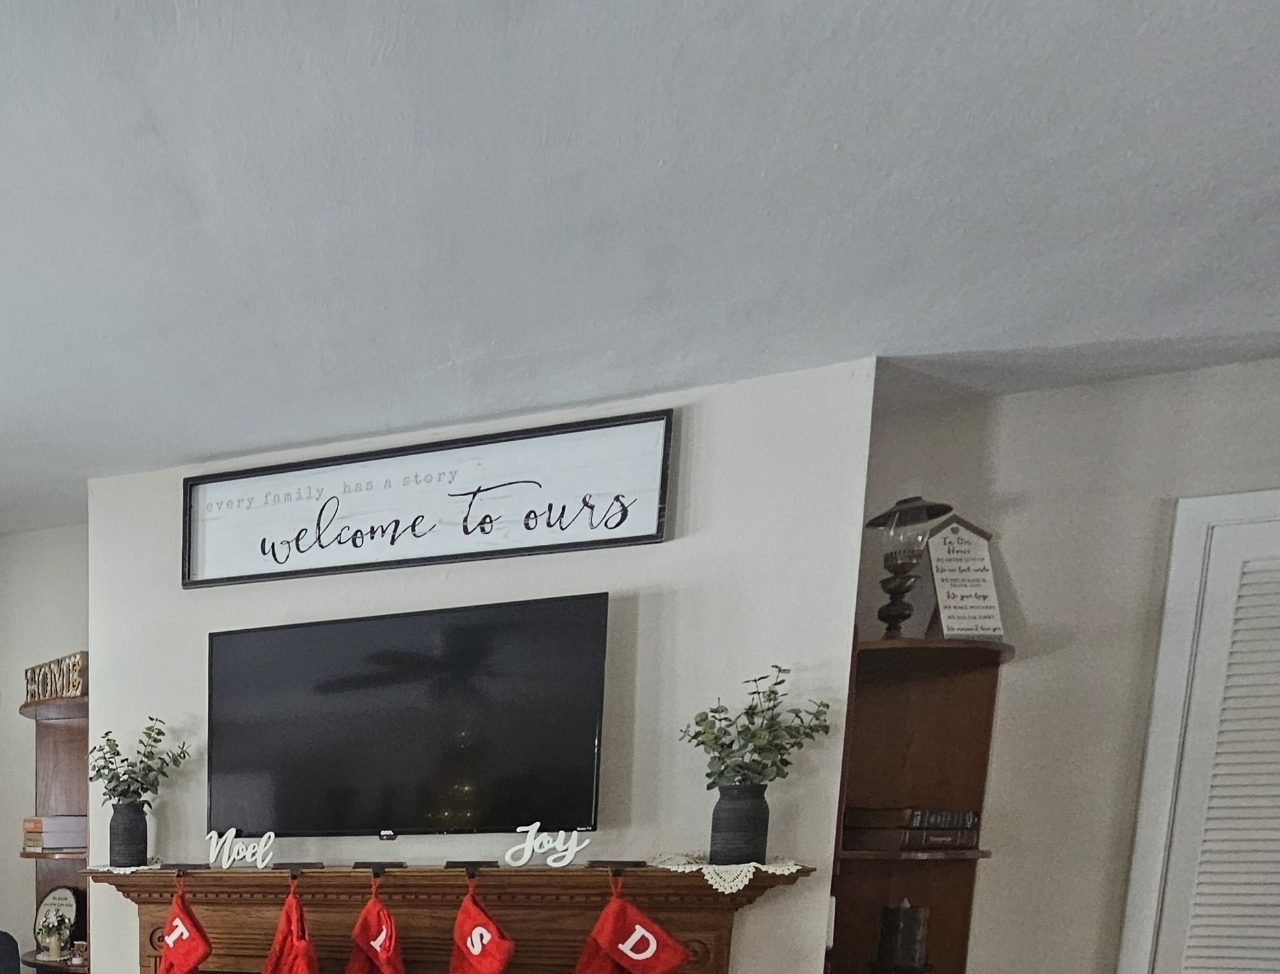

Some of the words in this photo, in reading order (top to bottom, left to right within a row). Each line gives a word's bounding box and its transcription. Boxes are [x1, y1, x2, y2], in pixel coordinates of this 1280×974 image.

[206, 496, 255, 513] every
[263, 485, 324, 507] family
[342, 481, 374, 495] has
[383, 479, 392, 489] a
[402, 469, 458, 488] story
[260, 496, 437, 564] welcome
[448, 480, 542, 536] to
[524, 492, 638, 531] ours
[25, 653, 83, 702] HOME
[206, 827, 275, 869] Noel
[505, 821, 590, 868] Joy
[164, 917, 190, 949] T
[466, 926, 492, 956] S
[618, 924, 658, 961] D
